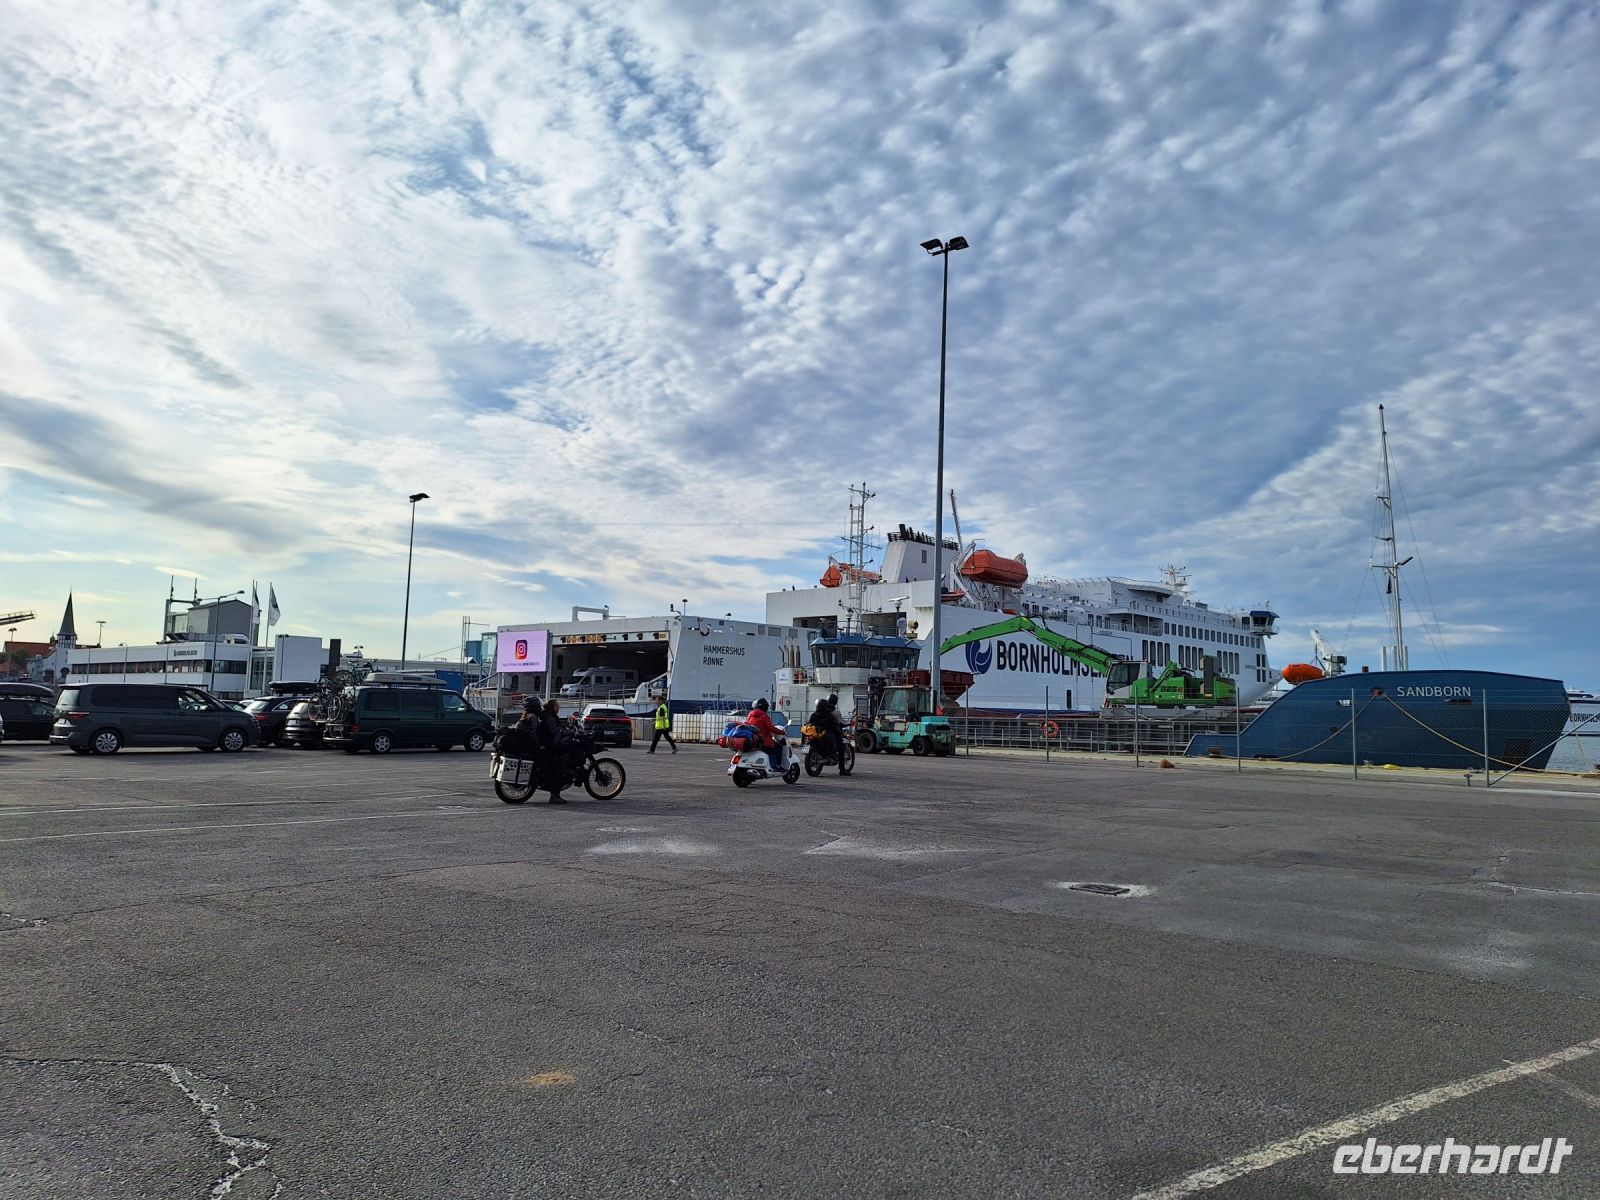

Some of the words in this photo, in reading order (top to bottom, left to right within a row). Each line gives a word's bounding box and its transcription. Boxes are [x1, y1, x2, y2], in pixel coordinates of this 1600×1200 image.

[703, 645, 746, 656] HAMMERSHUS
[996, 640, 1134, 678] BORNHOLM
[1397, 686, 1471, 697] SANDBORN
